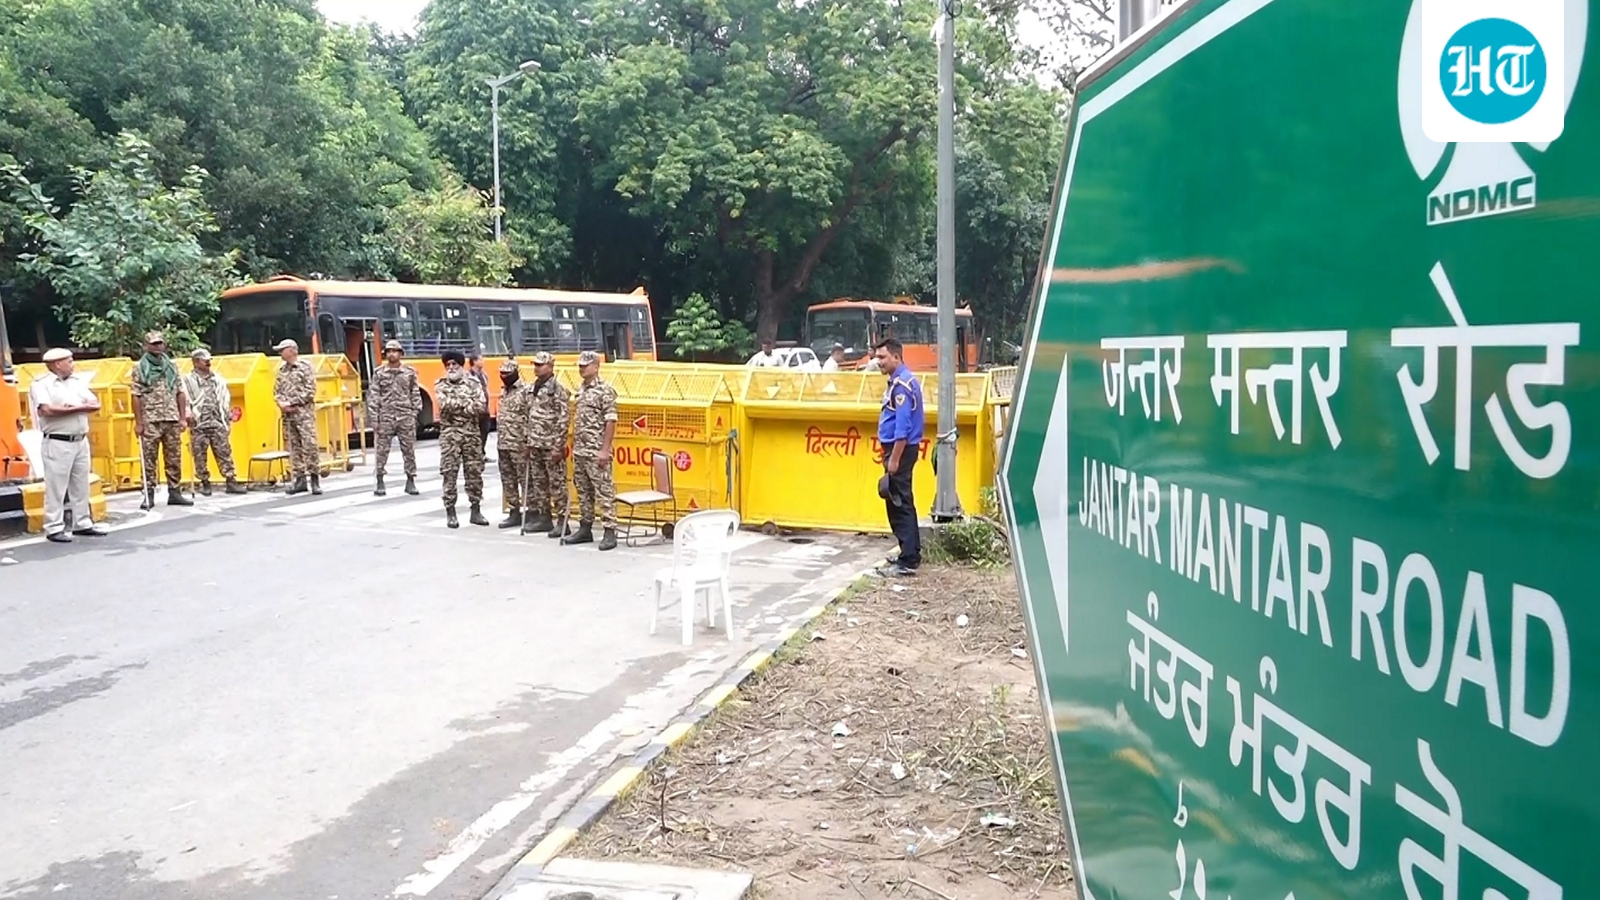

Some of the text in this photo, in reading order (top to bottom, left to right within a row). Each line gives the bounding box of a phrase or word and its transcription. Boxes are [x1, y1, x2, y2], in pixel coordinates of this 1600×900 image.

[1428, 175, 1534, 222] NDMC
[1100, 261, 1581, 479] जन्तर मन्तर रोड
[612, 446, 662, 467] OLIC
[805, 425, 861, 458] दिल्ली
[1079, 456, 1570, 747] JANTAR MANTAR ROAD
[1126, 591, 1214, 748] ਜੰਤਰ
[1226, 655, 1372, 870] ਮੰਤਰ
